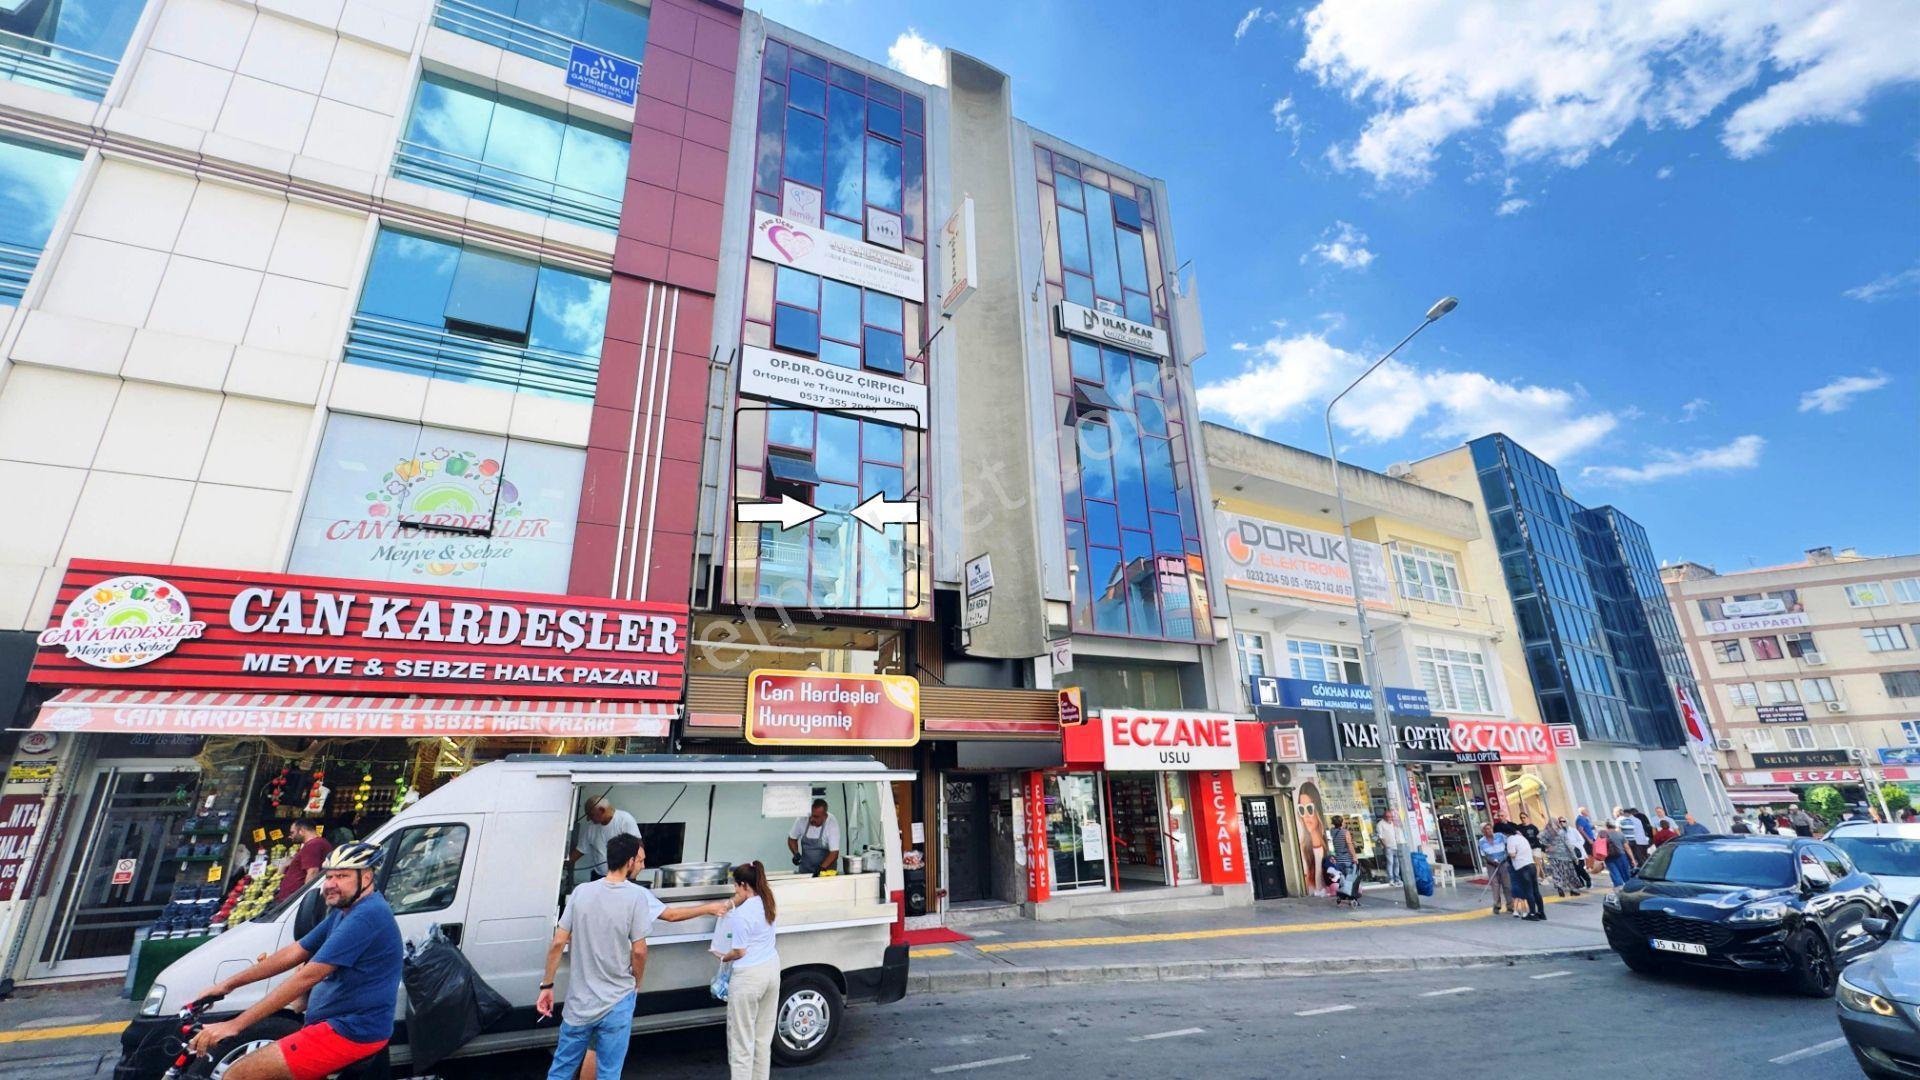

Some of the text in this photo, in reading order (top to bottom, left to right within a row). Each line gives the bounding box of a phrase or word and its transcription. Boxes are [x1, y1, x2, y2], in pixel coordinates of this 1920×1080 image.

[1102, 317, 1153, 339] ULAŞ ACAR
[752, 369, 919, 410] Ortopedi ve Travmatoloji Uzmanı
[770, 358, 905, 395] OP.DR.OĞUZ ÇIRPICI
[799, 391, 826, 403] 0537
[828, 397, 847, 409] 355
[326, 519, 391, 541] CAN
[1238, 520, 1348, 564] DORUK
[370, 544, 513, 567] Meyve & Sebze
[1259, 552, 1351, 580] ELEKTRONİK
[1246, 569, 1264, 582] 0232
[41, 623, 202, 643] CAN KARDEŞLER
[228, 587, 679, 655] CAN KARDEŞLER
[1732, 620, 1760, 630] DEM
[73, 639, 173, 659] Meyve & Sebze
[242, 652, 659, 686] MEYVE & SEBZE HALK PAZARI
[760, 680, 881, 707] Can Kardeşler
[1312, 683, 1349, 698] GÖKHAN
[113, 708, 167, 727] CAN
[174, 710, 316, 733] KARDEŞLER
[322, 711, 394, 731] MEYVE
[401, 713, 415, 730] &
[424, 713, 486, 731] SEBZE
[491, 715, 543, 732] HALK
[759, 705, 852, 734] Kuruyemiş
[1111, 716, 1232, 748] ECZANE
[1343, 722, 1455, 751] NARI OPTİK
[1452, 723, 1548, 754] eczane
[1159, 751, 1190, 764] USLU
[1456, 753, 1477, 762] NARLI
[1763, 755, 1799, 764] SELİM
[1793, 770, 1886, 781] ECZAE
[1024, 785, 1036, 888] ECZANE
[1035, 785, 1046, 888] ECZANE
[1212, 781, 1233, 872] ECZANE
